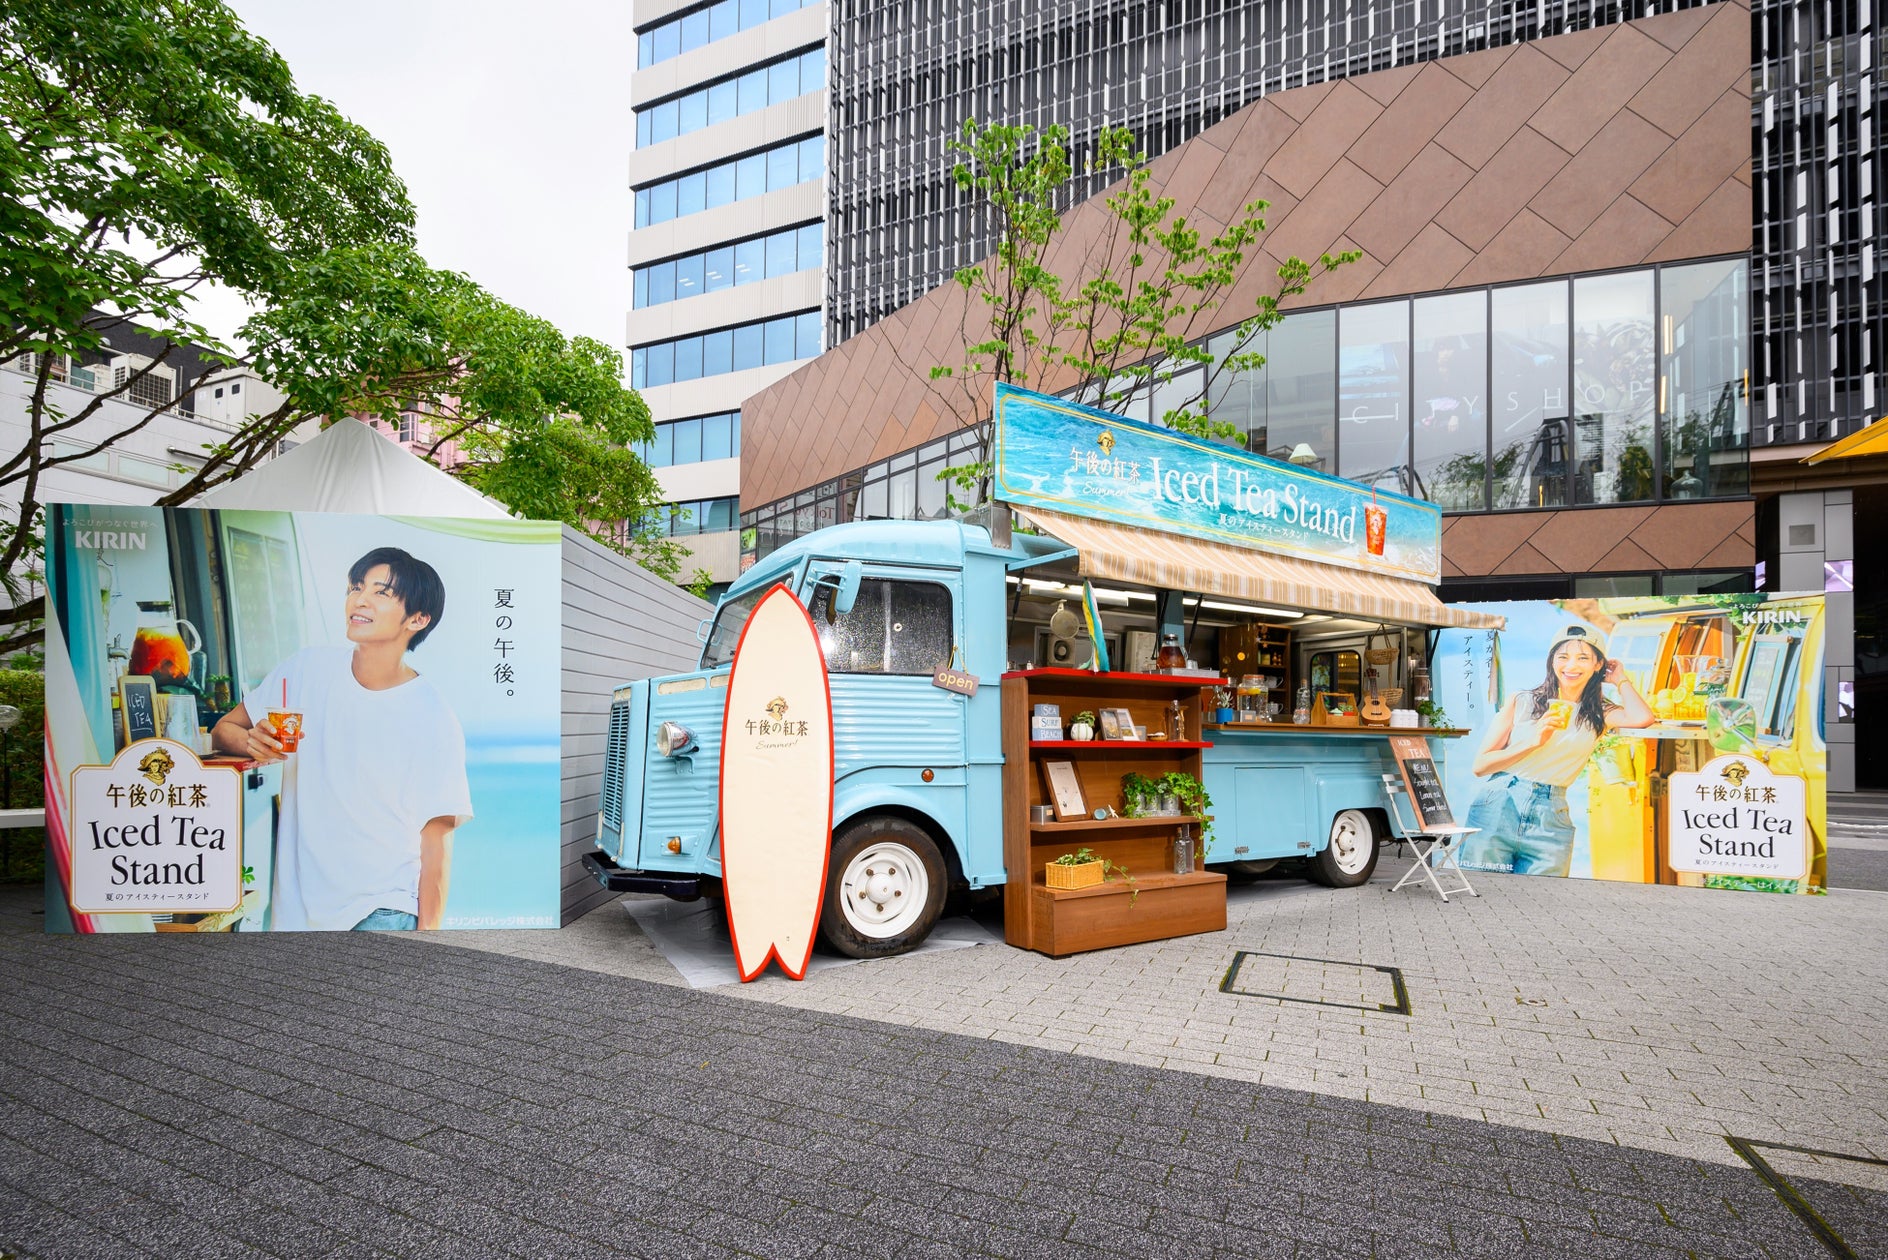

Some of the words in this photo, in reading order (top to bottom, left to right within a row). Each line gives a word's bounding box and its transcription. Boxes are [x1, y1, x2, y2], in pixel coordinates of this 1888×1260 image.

[1069, 446, 1141, 485] 午後の紅茶
[1149, 457, 1220, 508] Iced
[1228, 468, 1279, 520] Tea
[1283, 483, 1356, 544] Stand
[62, 519, 159, 529] よろこびがつなぐ世界へ
[1219, 513, 1309, 541] 夏のアイスティースタンド
[75, 530, 146, 550] KIRIN
[1742, 610, 1801, 624] KIRIN
[493, 588, 515, 697] 夏の午後。
[938, 672, 974, 690] open
[1463, 635, 1475, 710] アイスティー。
[128, 693, 145, 708] ICED
[134, 712, 152, 727] TEA
[745, 719, 808, 736] 午後の紅茶
[1408, 748, 1426, 758] TEA
[106, 783, 208, 808] 午後の紅茶
[1695, 784, 1777, 804] 午後の紅茶
[1681, 807, 1740, 830] Iced
[1746, 808, 1793, 835] Tea
[88, 814, 162, 850] Iced
[171, 814, 226, 850] Tea
[1699, 833, 1775, 858] Stand
[110, 853, 205, 885] Stand
[1695, 859, 1779, 870] 夏のアイスティースタンド
[105, 892, 209, 902] 夏のアイスティースタンド
[446, 916, 554, 926] キリンビバレッジ株式会社
